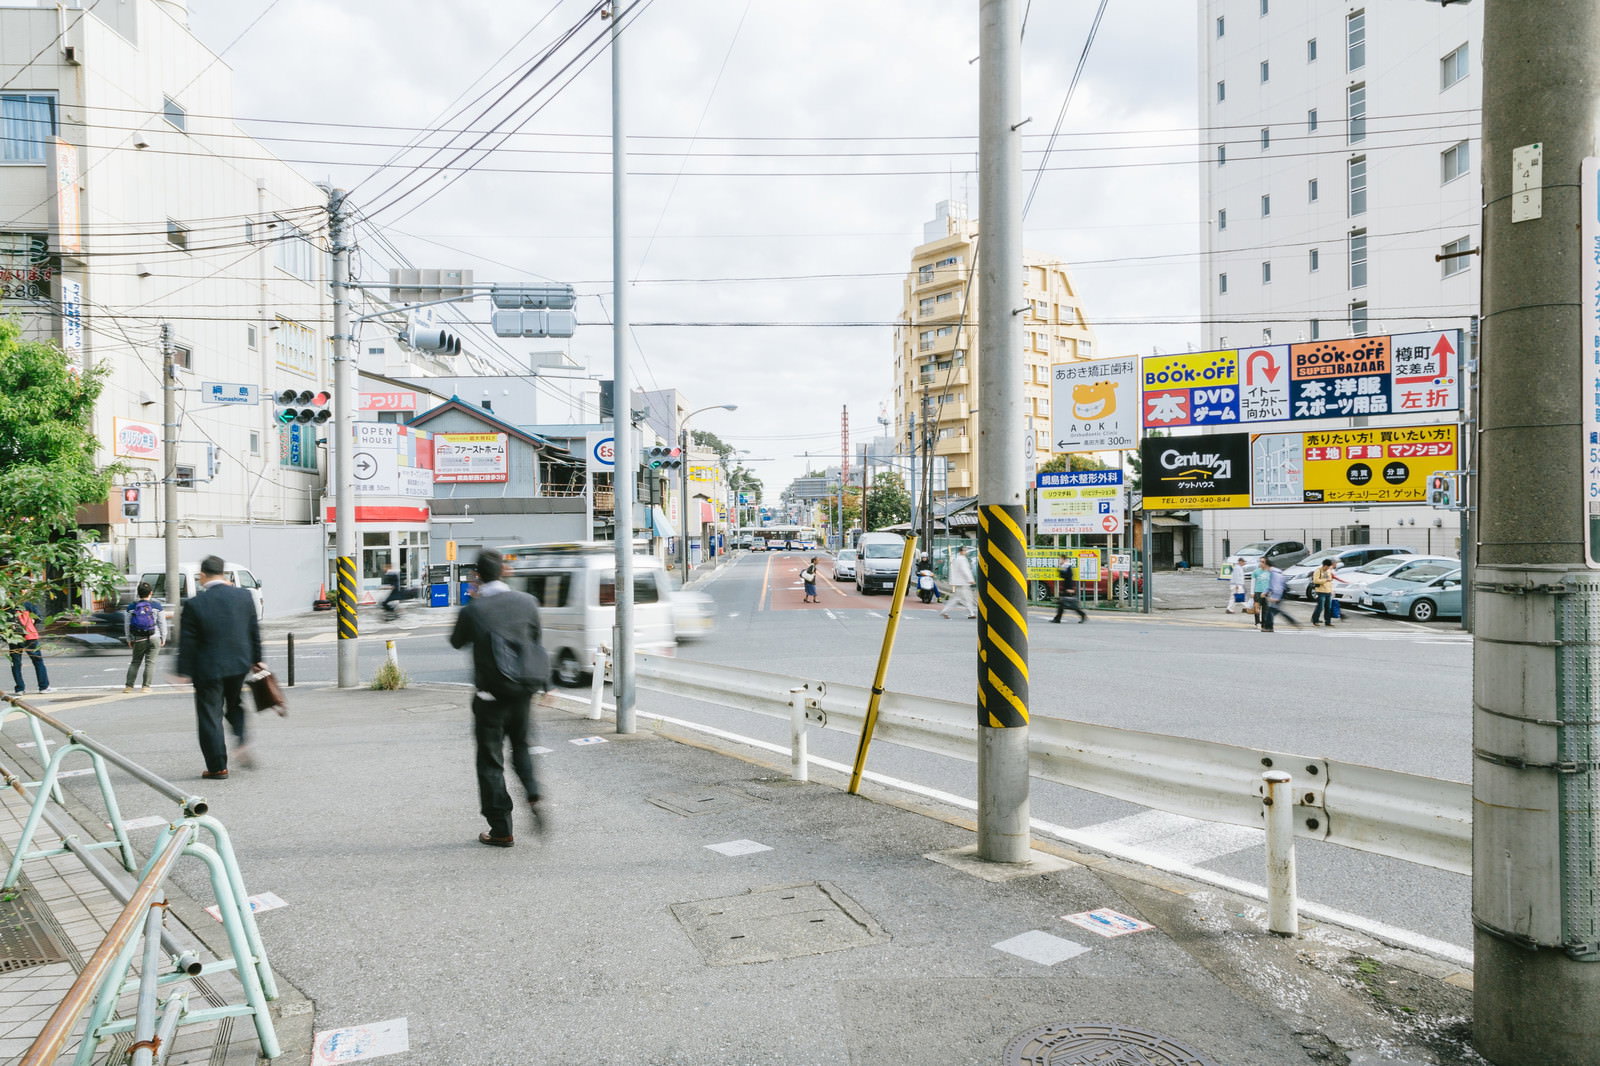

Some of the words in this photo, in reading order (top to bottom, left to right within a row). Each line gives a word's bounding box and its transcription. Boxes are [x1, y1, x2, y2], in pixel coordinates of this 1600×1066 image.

[1395, 346, 1431, 363] 樽町
[1056, 361, 1133, 380] あおき矯正歯科
[1299, 365, 1335, 377] SUPER
[1337, 361, 1385, 374] BAZAAR
[1395, 362, 1436, 376] 交差点
[214, 395, 248, 403] Tsunashima
[1193, 388, 1236, 405] DVD
[1248, 387, 1281, 398] イトー
[1401, 388, 1449, 409] 左折
[1147, 393, 1187, 423] 本
[1241, 396, 1288, 409] ヨーカドー
[1295, 395, 1388, 417] スポーツ用品
[1193, 406, 1237, 422] ゲーム
[1247, 407, 1282, 420] 向かい
[362, 427, 393, 436] OPEN
[1070, 421, 1118, 432] AOKI
[362, 436, 393, 445] HOUSE
[1107, 436, 1132, 446] 300m
[454, 444, 504, 454] ファーストホーム
[1307, 447, 1341, 461] 土地
[1347, 445, 1382, 460] 戸建
[1389, 443, 1452, 457] マンション
[1160, 449, 1220, 470] Century
[1213, 459, 1232, 479] 21
[1041, 472, 1118, 486] 綱島鈴木整形外科
[1177, 481, 1215, 489] ゲットハウス
[1179, 496, 1231, 504] 0120-540-844
[1327, 489, 1390, 499] センチュリー21
[1101, 503, 1109, 513] P
